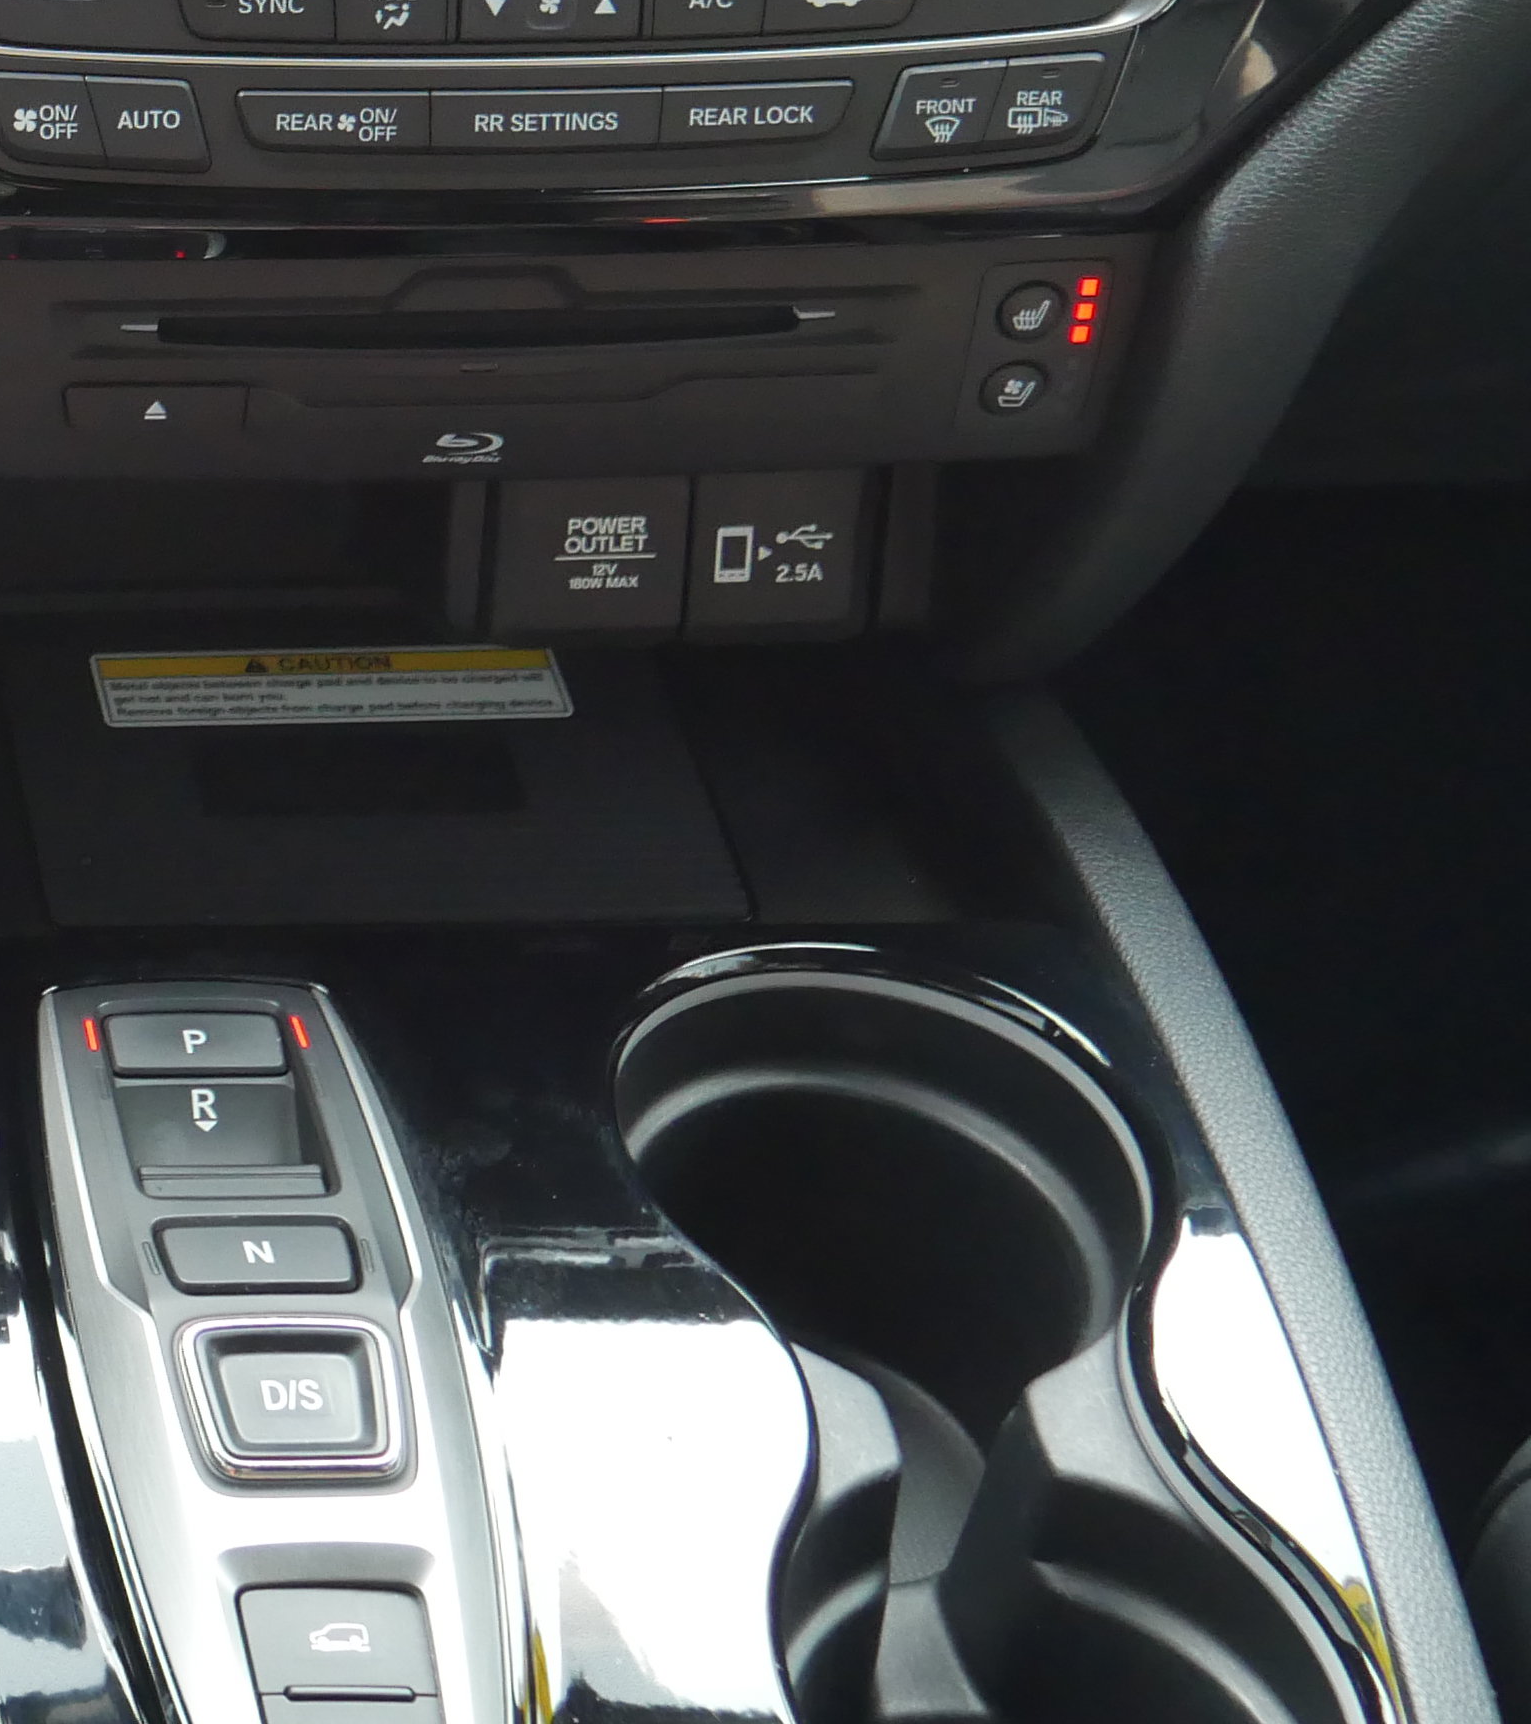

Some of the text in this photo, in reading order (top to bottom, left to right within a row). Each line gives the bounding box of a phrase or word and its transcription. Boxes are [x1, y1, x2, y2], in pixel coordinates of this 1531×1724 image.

[916, 97, 975, 116] FRONT
[1017, 90, 1063, 107] REAR
[39, 104, 78, 122] ON/
[117, 111, 180, 130] AUTO
[276, 113, 333, 132] REAR
[359, 107, 397, 126] ON/
[475, 112, 618, 133] RR SETTINGS
[690, 105, 814, 127] REAR LOCK
[39, 122, 78, 140] OFF
[359, 125, 397, 142] OFF
[568, 516, 646, 536] POWER
[564, 535, 649, 553] OUTLET
[593, 564, 617, 575] 12V
[776, 564, 824, 583] 2.5A
[606, 576, 638, 589] MAX
[277, 656, 391, 673] CAUTION
[183, 1031, 206, 1053] P
[192, 1090, 216, 1119] R
[244, 1241, 274, 1263] N
[262, 1380, 322, 1410] D/S
